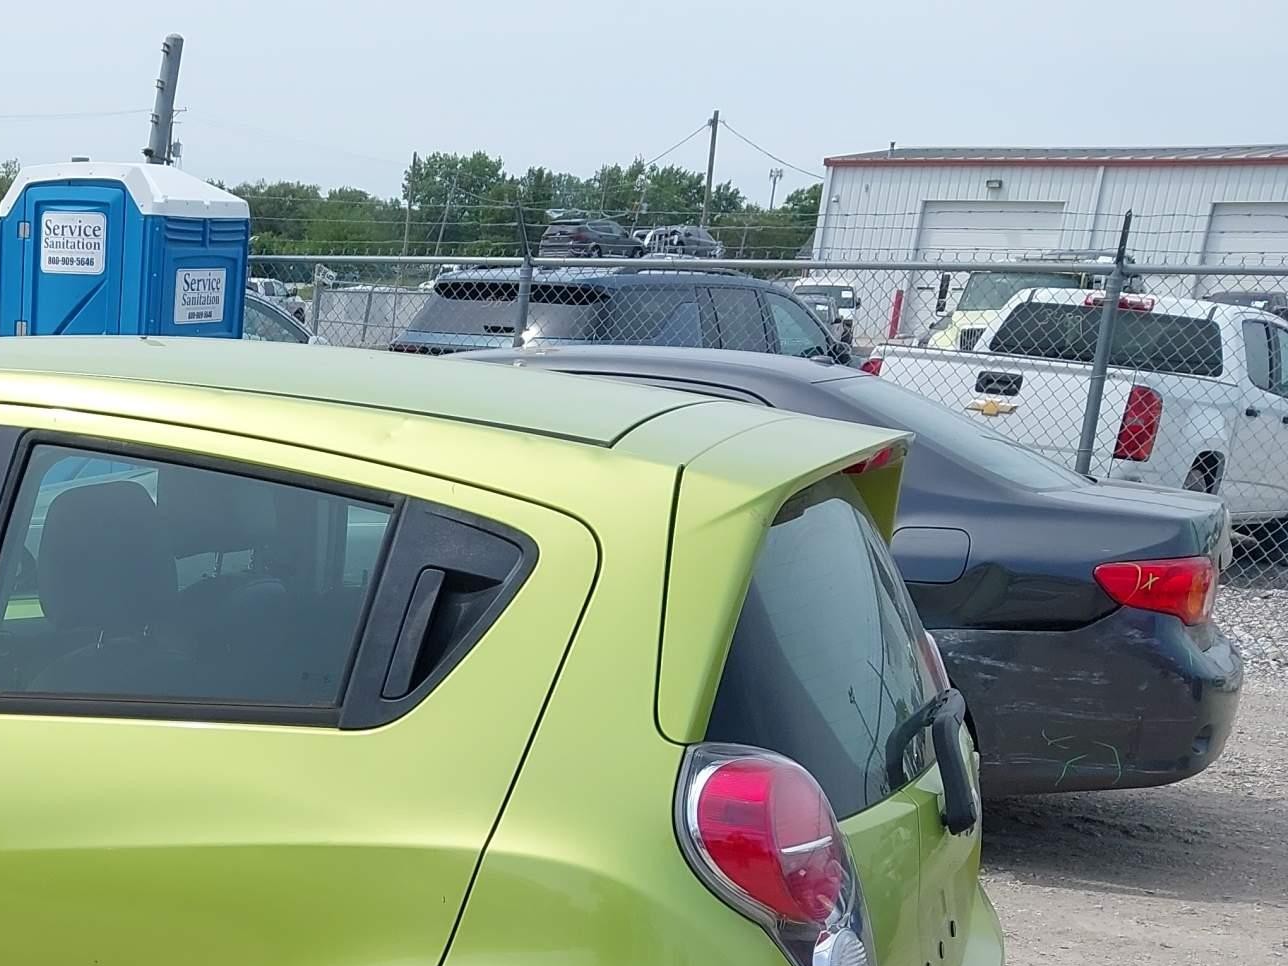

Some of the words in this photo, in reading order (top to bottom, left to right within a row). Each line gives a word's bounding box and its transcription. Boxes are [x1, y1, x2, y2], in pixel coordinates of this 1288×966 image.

[45, 219, 101, 237] Service
[44, 238, 100, 250] Sanitation
[48, 256, 94, 266] 800-909-5646
[183, 272, 221, 291] Service
[182, 292, 220, 306] Sanitation
